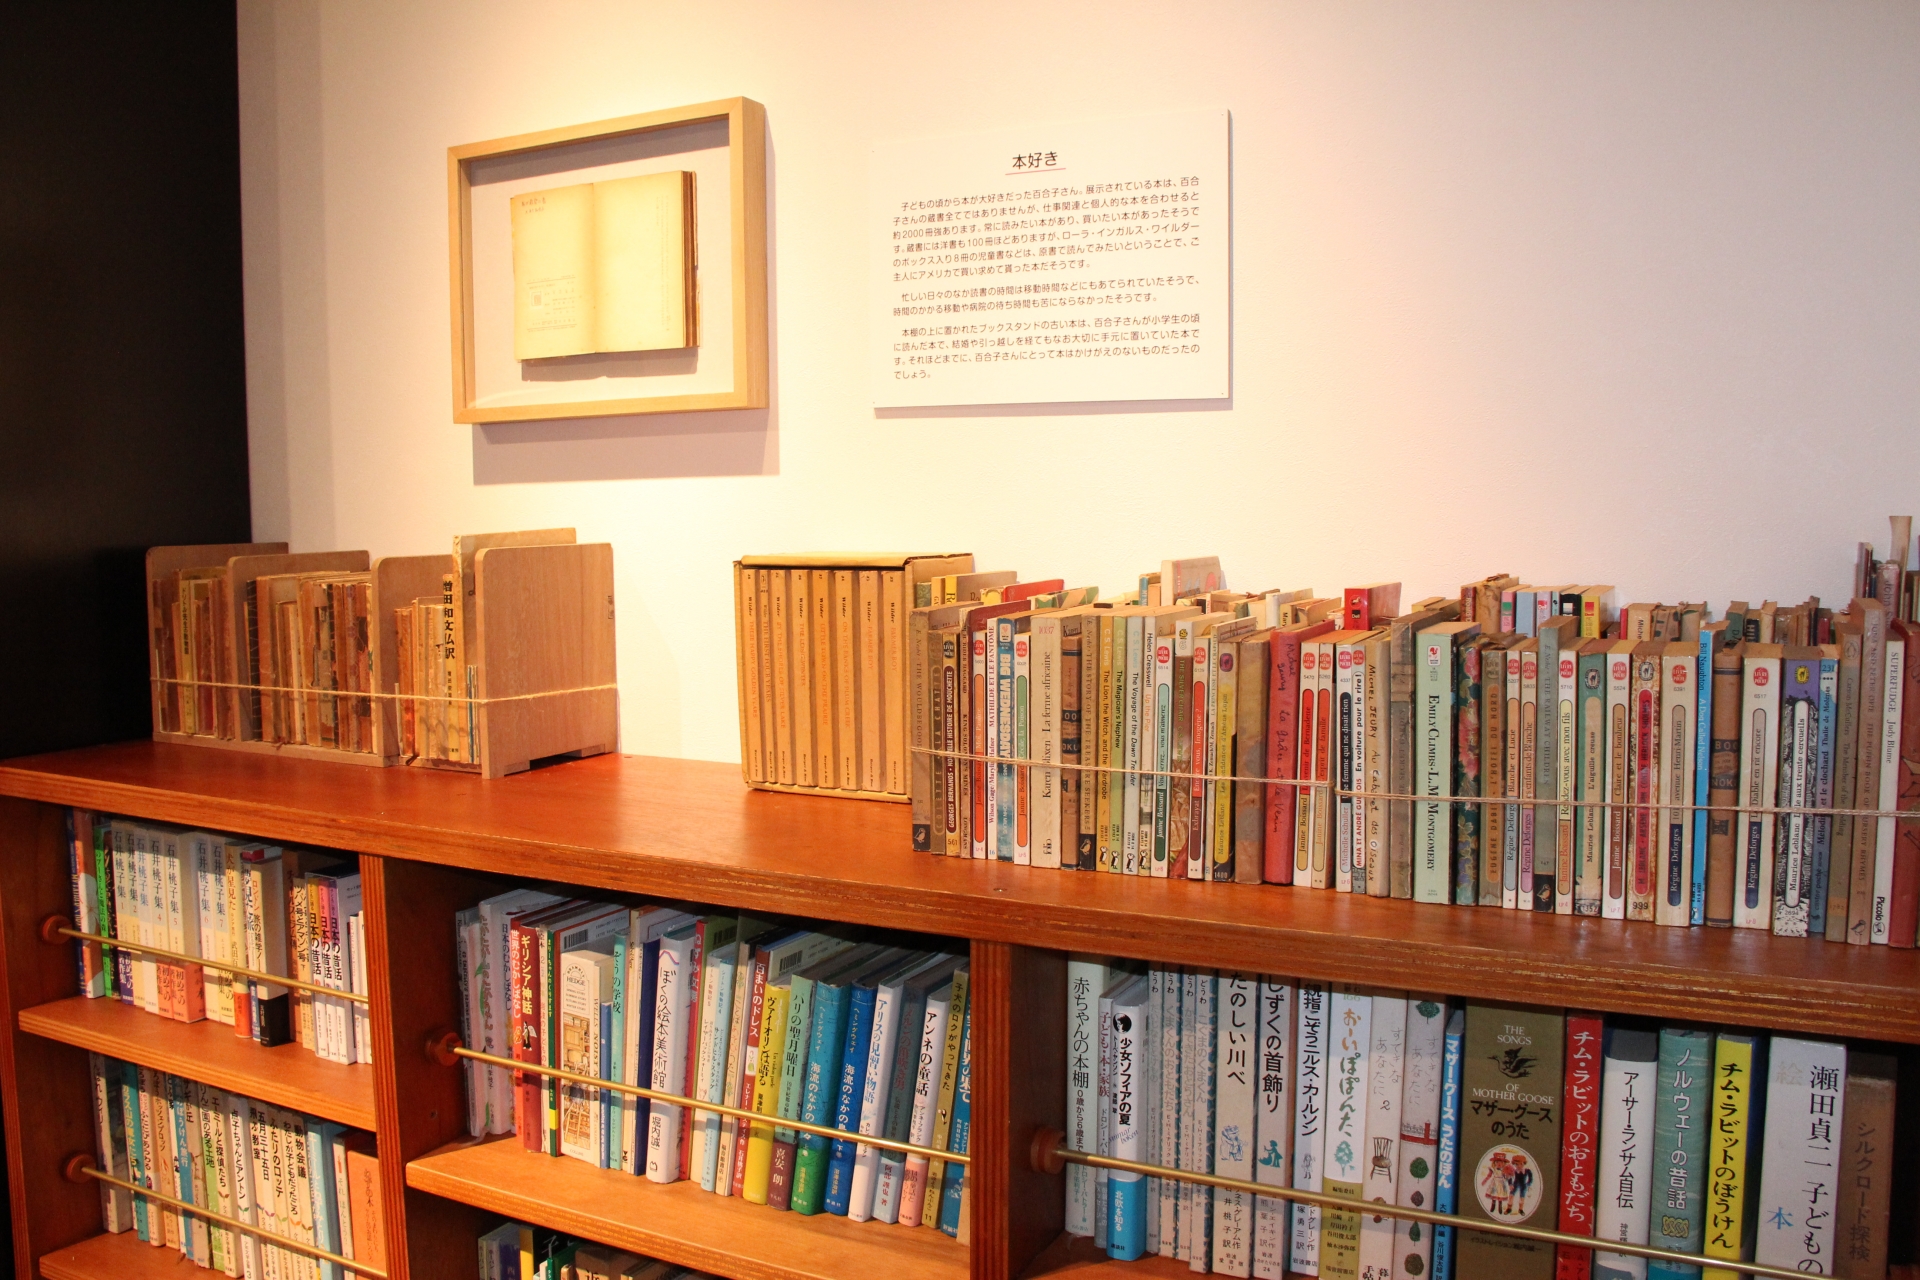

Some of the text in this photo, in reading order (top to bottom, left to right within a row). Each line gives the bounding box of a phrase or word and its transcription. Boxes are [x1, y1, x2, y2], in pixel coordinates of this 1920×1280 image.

[1012, 151, 1059, 170] 本好き
[893, 191, 1199, 226] 子さんの蔵書全てではありませんが、仕事関連と個人的な本を合わせると
[901, 176, 1199, 212] 子どもの頃から本が大好きだった百合子さん。展示されている本は、百合
[893, 206, 1199, 240] 約2000冊強あります。常に読みたい本があり、買いたい本があったそうで
[893, 222, 1199, 253] す。蔵書には洋書も100冊ほどありますが、ローラ・インガルス・ワイルダー
[893, 237, 1199, 267] のボックス入り8冊の児童書などは、原書で読んでみたいということで、こ
[893, 259, 1091, 282] 主人にアメリカで買い求めて貰った本だそうです。
[893, 294, 1157, 316] 時間のかかる移動や病院の待ち時間も苦にならなかったそうです。
[902, 275, 1199, 302] 忙しい日々のなか読書の時間は移動時間などにもあてられていたそうで、
[893, 328, 1199, 352] に読んだ本で、結婚や引っ越しを経てもなお大切に手元に置いていた本で
[902, 312, 1200, 338] 本棚の上に置かれたブックスタンドの古い本は、百合子さんが小学生の頃
[894, 343, 1200, 366] す。それほどまでに、百合子さんにとって本はかけがえのないものだったの
[894, 369, 932, 381] でしょう。
[987, 626, 995, 663] FANTÔME
[1699, 642, 1707, 653] Bill
[1822, 664, 1835, 672] 231
[934, 671, 942, 721] CHATTE
[1699, 655, 1707, 691] Naughton
[1000, 654, 1011, 758] BIG WEDNESDAY
[1114, 685, 1122, 720] Magician's
[1130, 687, 1138, 711] Voyage
[1698, 706, 1706, 720] Dog
[1885, 652, 1900, 764] SUPERFUDGE Judy Blume
[1042, 651, 1052, 798] Karen ferme africaine
[1354, 731, 1362, 760] voiture
[1674, 720, 1682, 770] Henri-Martin
[1427, 695, 1440, 871] EMILY CLIMBS MONTGOMERY
[1524, 763, 1532, 790] enfants
[1588, 757, 1596, 790] L'aiguille
[1697, 746, 1705, 771] Nelson
[1820, 751, 1829, 785] clochard
[947, 772, 955, 802] BERNANOS
[1300, 797, 1308, 827] Boissard
[1612, 717, 1623, 871] Janine Boissard Claire bonheur
[1752, 782, 1761, 807] Diable
[1523, 813, 1531, 846] Deforges
[1560, 825, 1569, 859] Boissard
[1671, 828, 1682, 863] Deforges
[1748, 826, 1759, 859] Deforges
[1791, 824, 1799, 855] Leblanc
[114, 832, 126, 898] 石井桃子集
[127, 833, 138, 901] 石井桃子集
[137, 838, 149, 906] 石井桃子集
[151, 840, 163, 910] 石井桃子集
[167, 844, 179, 914] 石井桃子集
[198, 842, 210, 912] 石井桃子集
[213, 845, 225, 916] 石井桃子集
[226, 853, 236, 911] 犬が星見た
[1670, 865, 1681, 892] Régine
[1747, 861, 1758, 889] Régine
[1789, 857, 1798, 891] Maurice
[1632, 902, 1649, 910] 999
[1875, 896, 1885, 921] Piccolo
[309, 913, 322, 976] 日本の昔話
[321, 917, 333, 979] 日本の昔話
[331, 917, 343, 981] 日本の昔話
[502, 923, 512, 1011] 日本のむかしばなし
[511, 930, 521, 1018] 世界のむかしばなし
[521, 934, 533, 1015] ギリシア神話
[566, 977, 586, 986] HEDGE
[613, 951, 622, 1014] ぞうの学校
[750, 963, 766, 1037] 百まいのドレス
[653, 970, 676, 1088] ぼくの絵本美術館
[758, 997, 777, 1087] ヴァイオリンは語る
[786, 994, 805, 1077] パリの聖月曜日
[864, 999, 888, 1104] アリスの見習い物語
[942, 982, 964, 1091] 子犬のロクがやってきた
[1072, 977, 1090, 1088] 赤ちゃんの本棚
[1226, 972, 1248, 1086] たのしい川べ
[1263, 972, 1285, 1114] しずくの首飾り
[1497, 1034, 1533, 1046] SONGS
[1503, 1024, 1526, 1036] THE
[916, 1012, 938, 1097] アンネの童話
[1196, 1015, 1208, 1104] こぐまのくまくん
[1301, 983, 1322, 1136] 親指こぞうニルス・カールソン
[1373, 1037, 1388, 1097] あなたに
[1391, 1028, 1404, 1084] すてきな
[1410, 1046, 1425, 1107] あなたに
[1424, 1037, 1439, 1093] すてきな
[1118, 1037, 1133, 1126] 少女ソフィアの夏
[1472, 1088, 1555, 1105] MOTHER GOOSE
[1505, 1082, 1521, 1094] OF
[1437, 1039, 1461, 1190] マザー・グース うたのほん
[1470, 1100, 1553, 1122] マザー・グース
[1491, 1122, 1530, 1140] のうた
[1565, 1031, 1595, 1223] チム・ラビットのおともだち
[1667, 1048, 1693, 1210] ノルウェーの昔話
[1803, 1065, 1840, 1168] 瀬田貞二
[212, 1098, 226, 1188] エーミールと探偵たち
[230, 1110, 246, 1200] 点子ちゃんとアントン
[257, 1111, 270, 1181] 五月三十五日
[270, 1118, 284, 1198] ふたりのロッテ
[294, 1125, 307, 1179] 動物会議
[1615, 1071, 1640, 1210] アーサー・ランサム自伝
[1710, 1063, 1744, 1250] チム・ラビットのぼうけん
[924, 1213, 933, 1221] 11
[1114, 1191, 1124, 1232] 北欧を知る
[1848, 1123, 1876, 1262] シルクロード探検
[1766, 1206, 1795, 1230] 本
